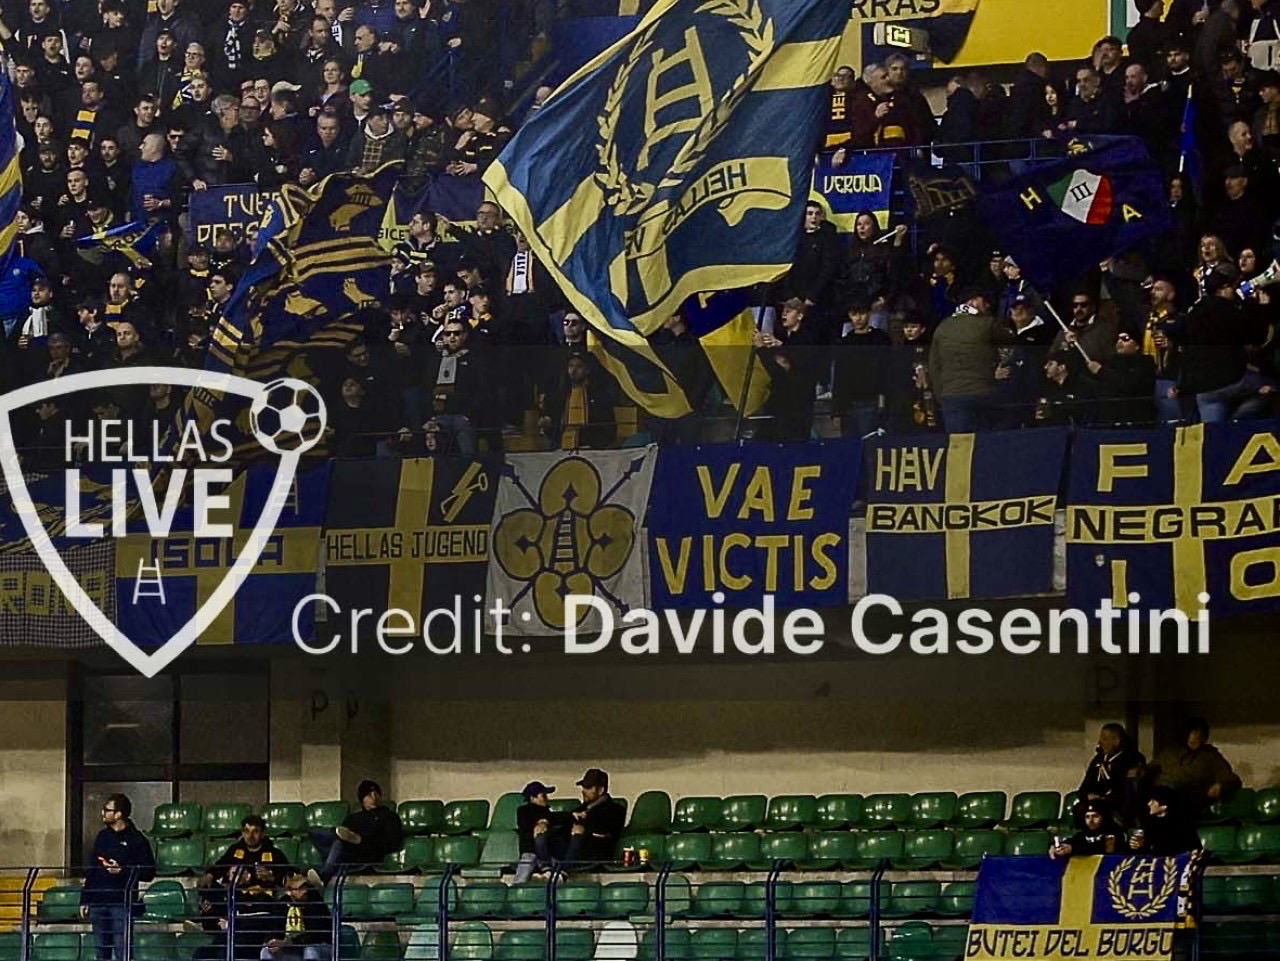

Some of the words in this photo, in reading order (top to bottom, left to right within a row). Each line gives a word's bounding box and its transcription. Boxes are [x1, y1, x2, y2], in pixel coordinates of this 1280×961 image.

[825, 174, 882, 194] VERONA
[1020, 187, 1042, 210] H
[1070, 182, 1092, 202] III
[1122, 203, 1143, 222] A
[696, 463, 822, 522] VAE
[871, 497, 1055, 531] BANGKOK
[326, 532, 403, 561] HELLAS
[410, 528, 488, 559] JUGEND
[656, 533, 841, 594] VICTIS
[1044, 929, 1090, 957] DEL
